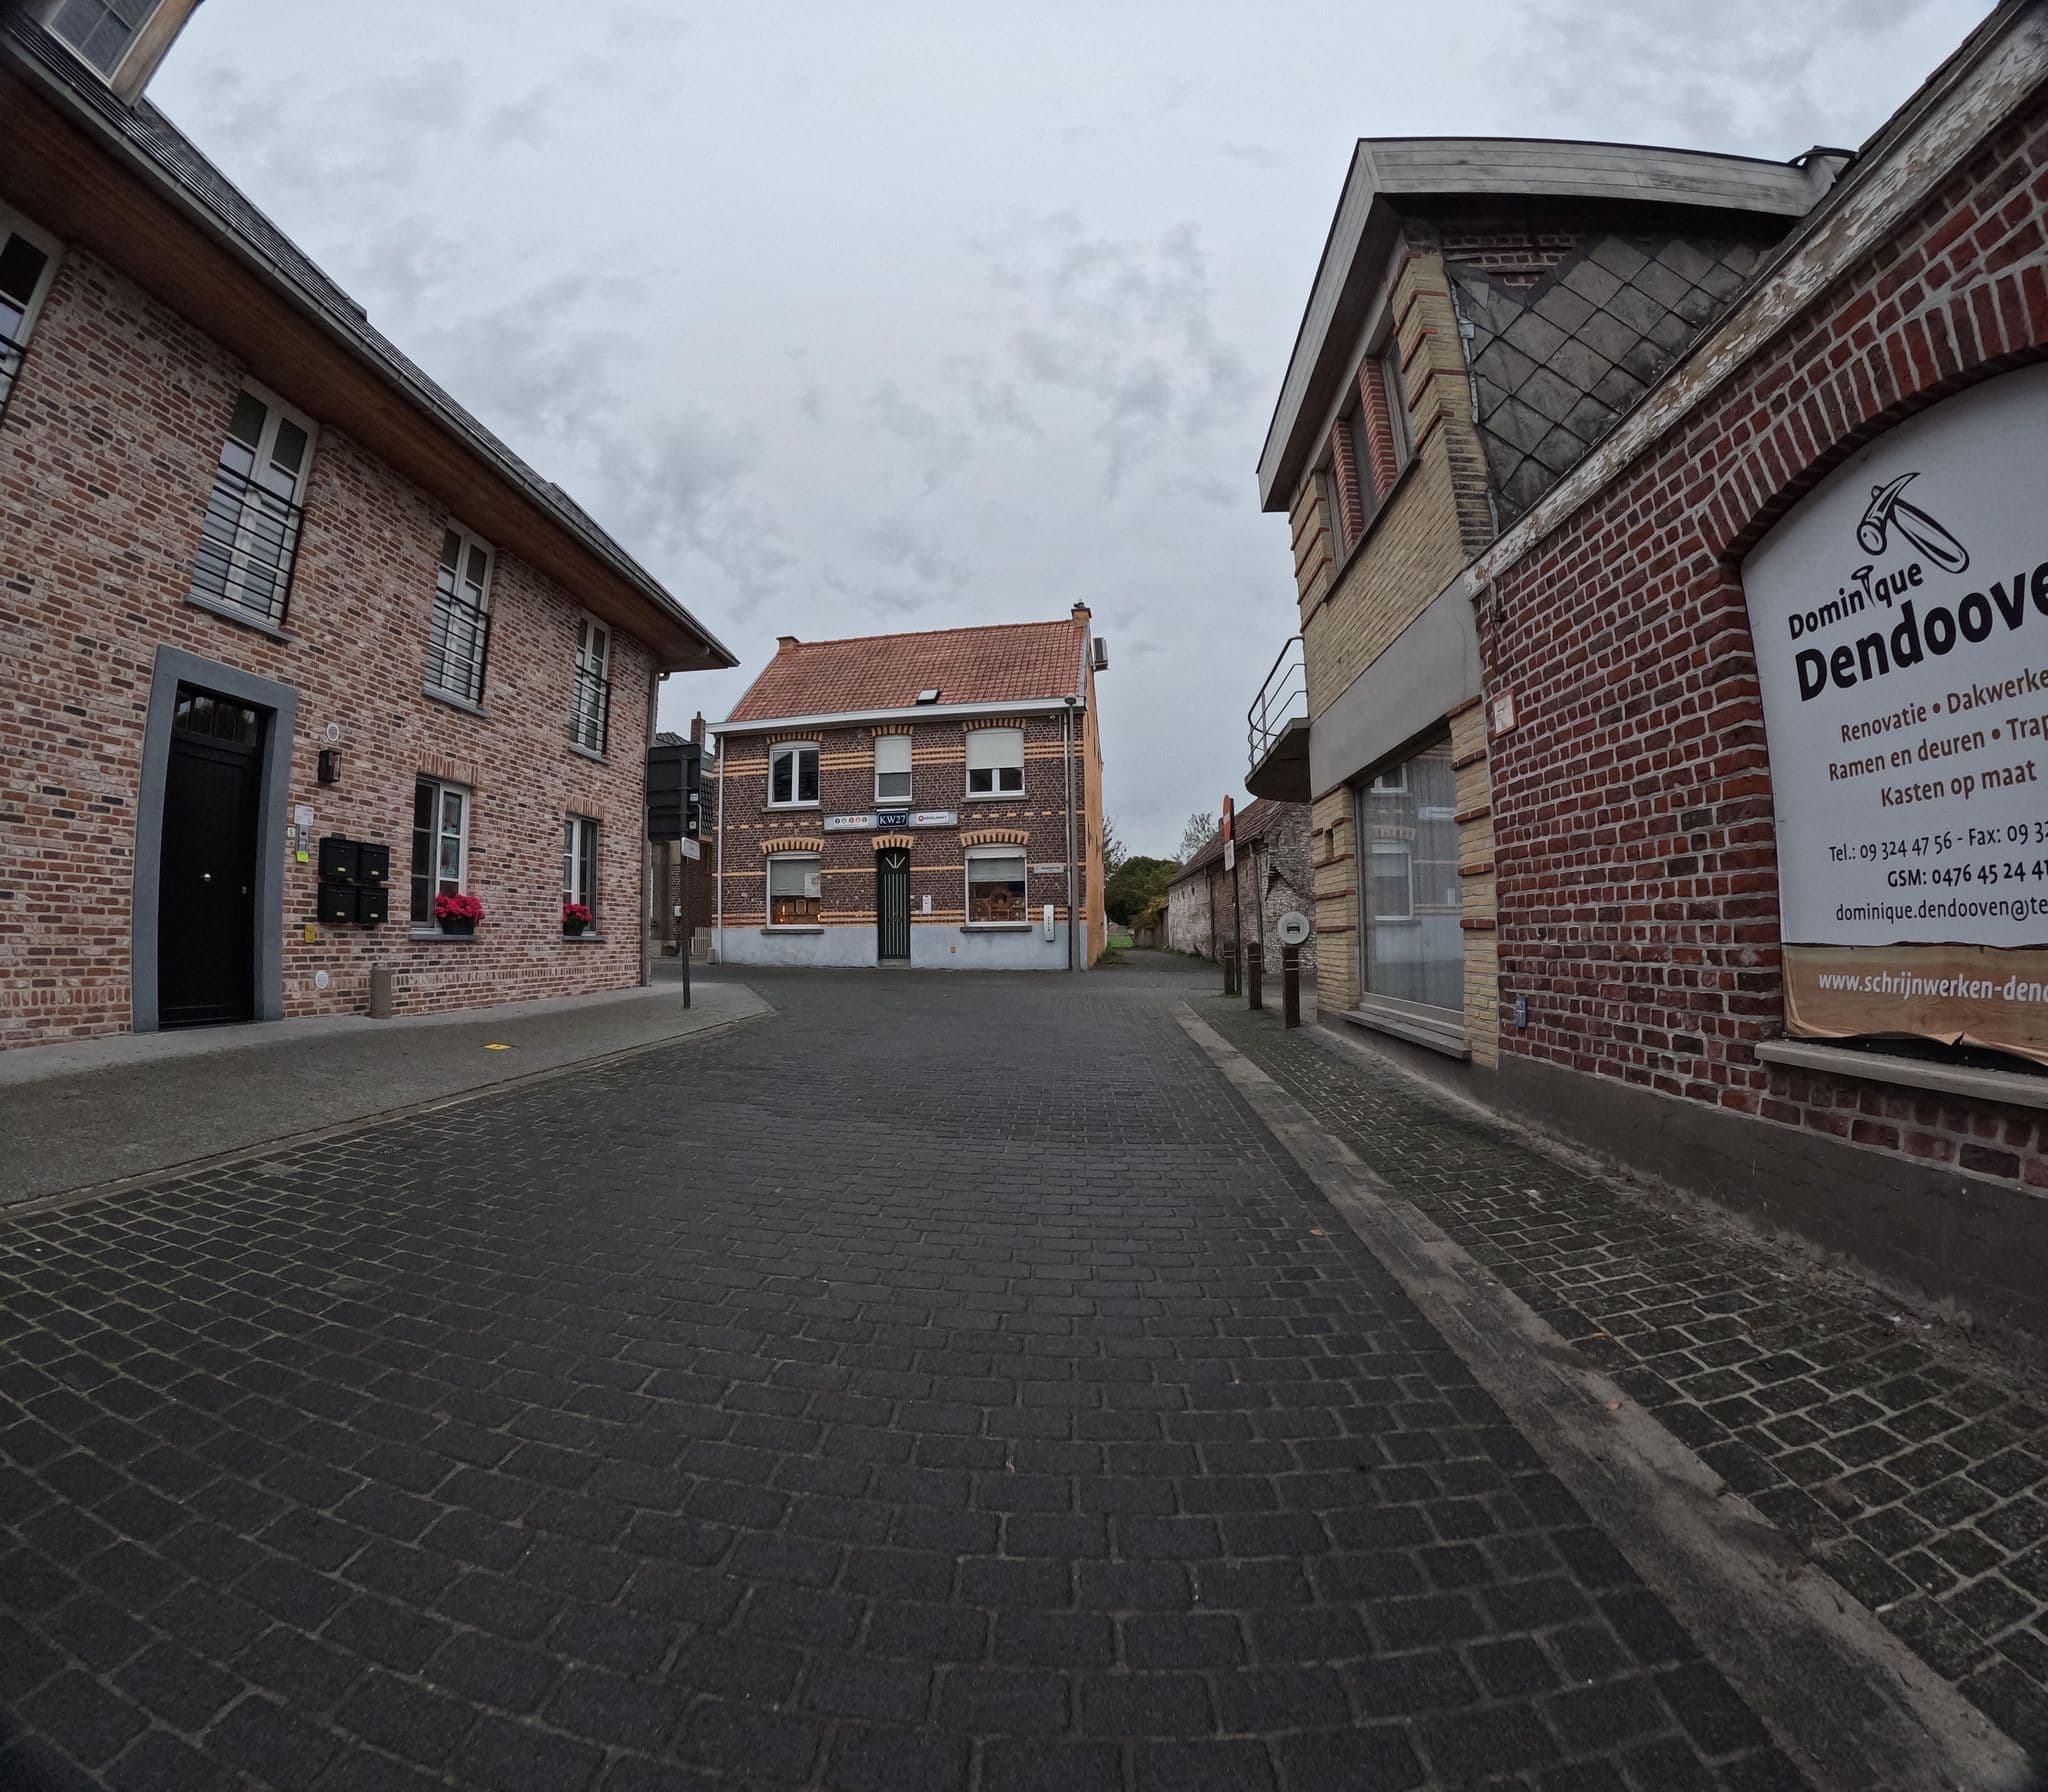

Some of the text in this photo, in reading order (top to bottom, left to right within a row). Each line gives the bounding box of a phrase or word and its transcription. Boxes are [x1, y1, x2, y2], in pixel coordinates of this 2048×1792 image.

[1788, 563, 1924, 640] Dominique
[1841, 668, 2048, 743] Renovatie Dakwerke
[1829, 752, 1886, 781] Ramen
[1891, 748, 1912, 767] en
[1918, 730, 1985, 761] deuren
[1881, 760, 2038, 807] Kasten op maat
[880, 815, 906, 825] KW27
[1829, 843, 1856, 862] Tel.:
[1860, 843, 1877, 862] 09
[1882, 840, 1908, 860] 324
[1912, 837, 1930, 856] 47
[1934, 831, 1952, 855] 56
[1969, 828, 2001, 846] Fax:
[2007, 824, 2028, 845] 09
[1888, 869, 1927, 887] GSM:
[1932, 864, 1972, 887] 0476
[1978, 864, 1998, 885] 45
[2003, 862, 2026, 882] 24
[1836, 896, 2048, 924] dominique.dendooven@te
